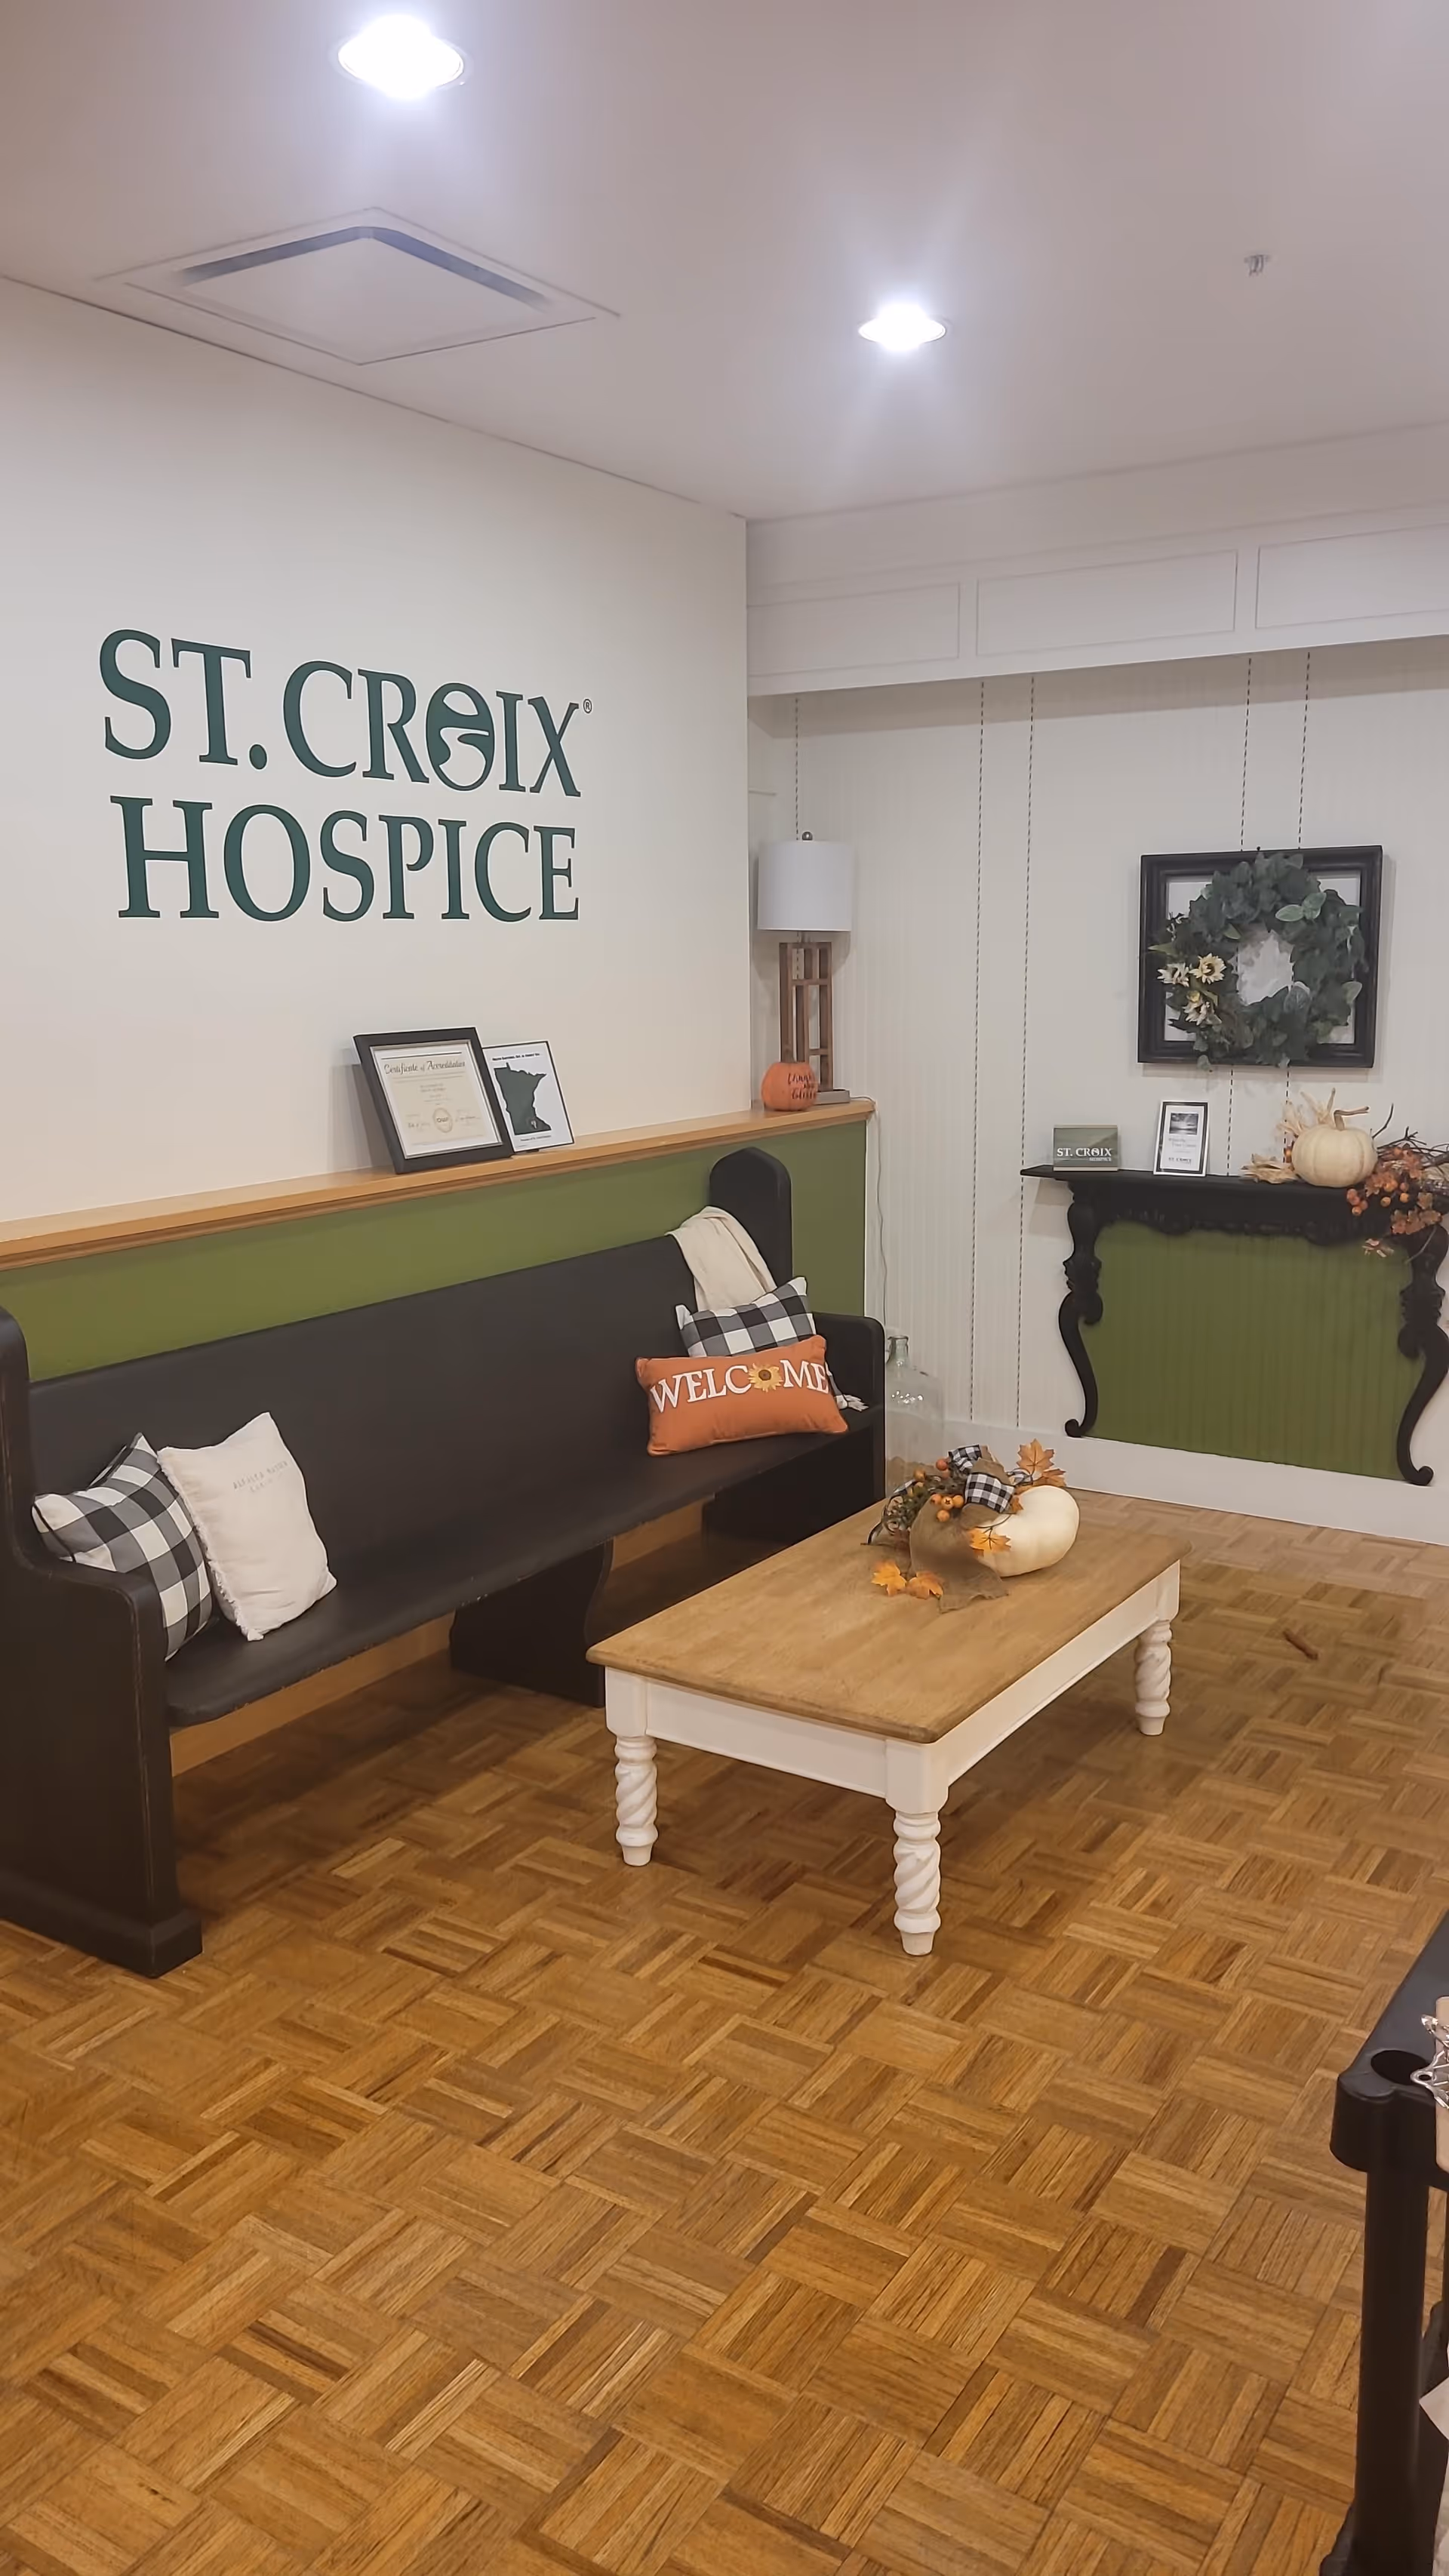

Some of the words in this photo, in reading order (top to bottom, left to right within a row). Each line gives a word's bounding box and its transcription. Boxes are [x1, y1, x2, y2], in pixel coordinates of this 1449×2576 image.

[99, 629, 267, 770] ST.
[110, 796, 579, 922] HOSPICE
[1057, 1147, 1073, 1157] ST.
[1075, 1147, 1112, 1157] CROIX
